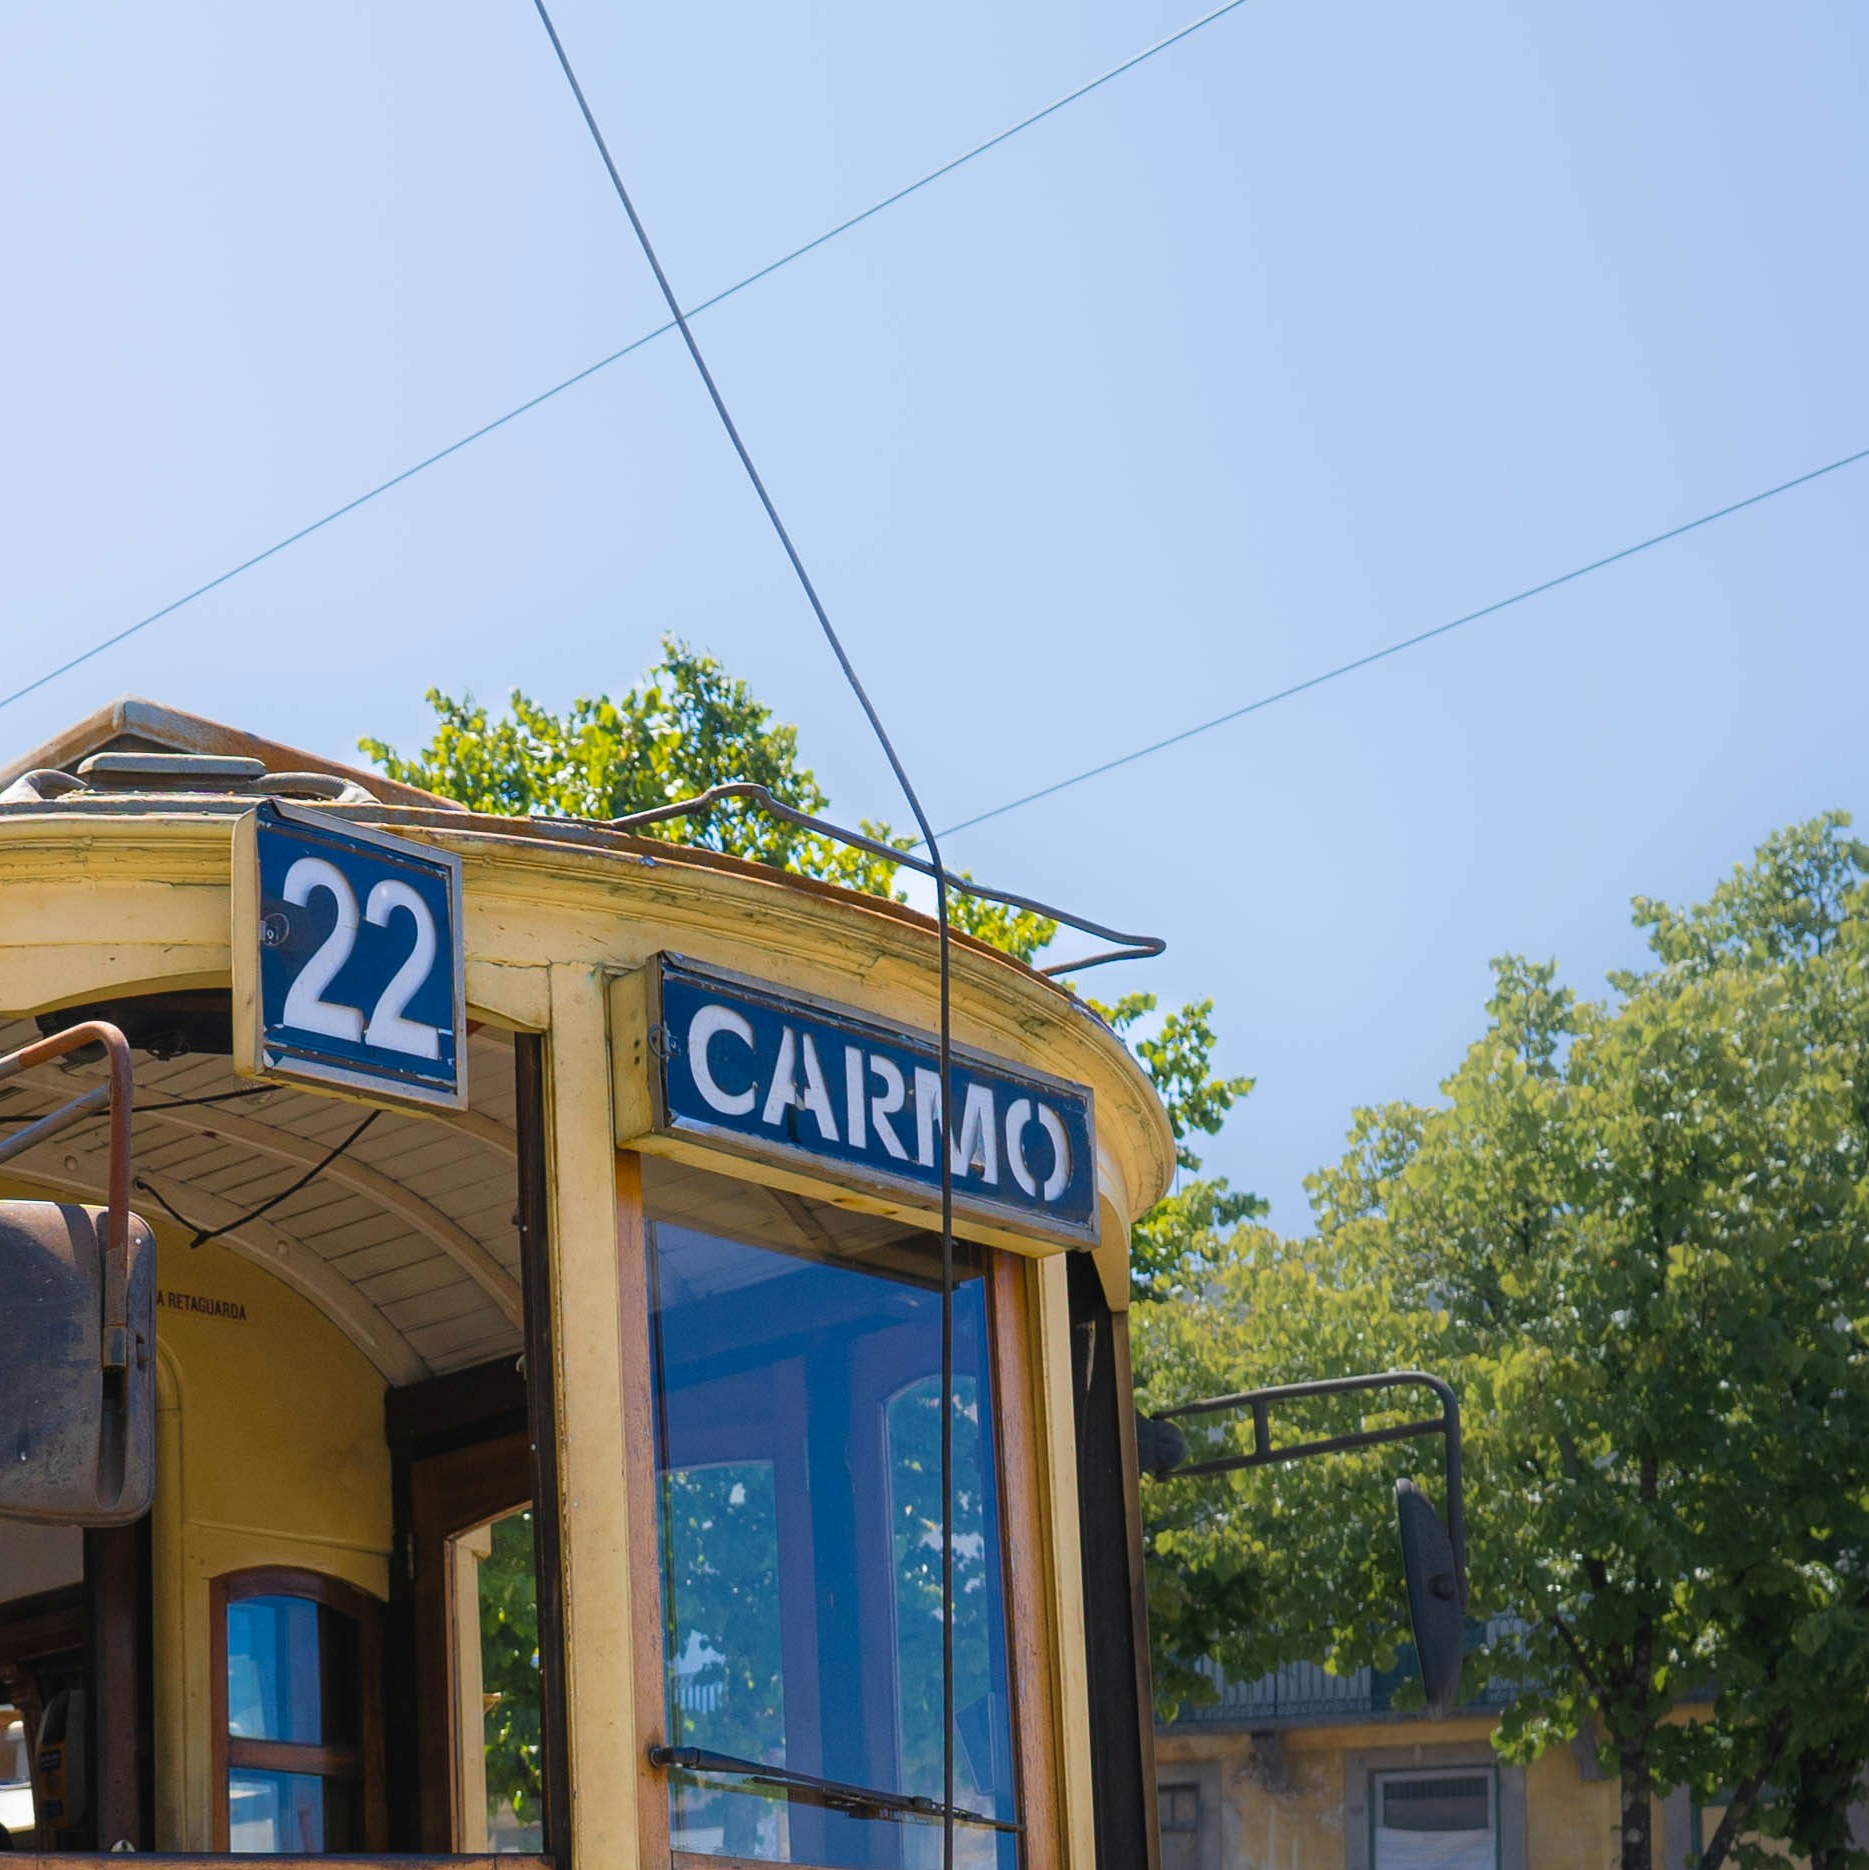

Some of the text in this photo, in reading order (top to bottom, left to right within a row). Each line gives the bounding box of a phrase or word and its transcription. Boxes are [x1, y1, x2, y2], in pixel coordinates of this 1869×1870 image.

[283, 856, 441, 1061] 22
[688, 1003, 1073, 1202] CARMO
[168, 1291, 247, 1321] RETAGUARDA
